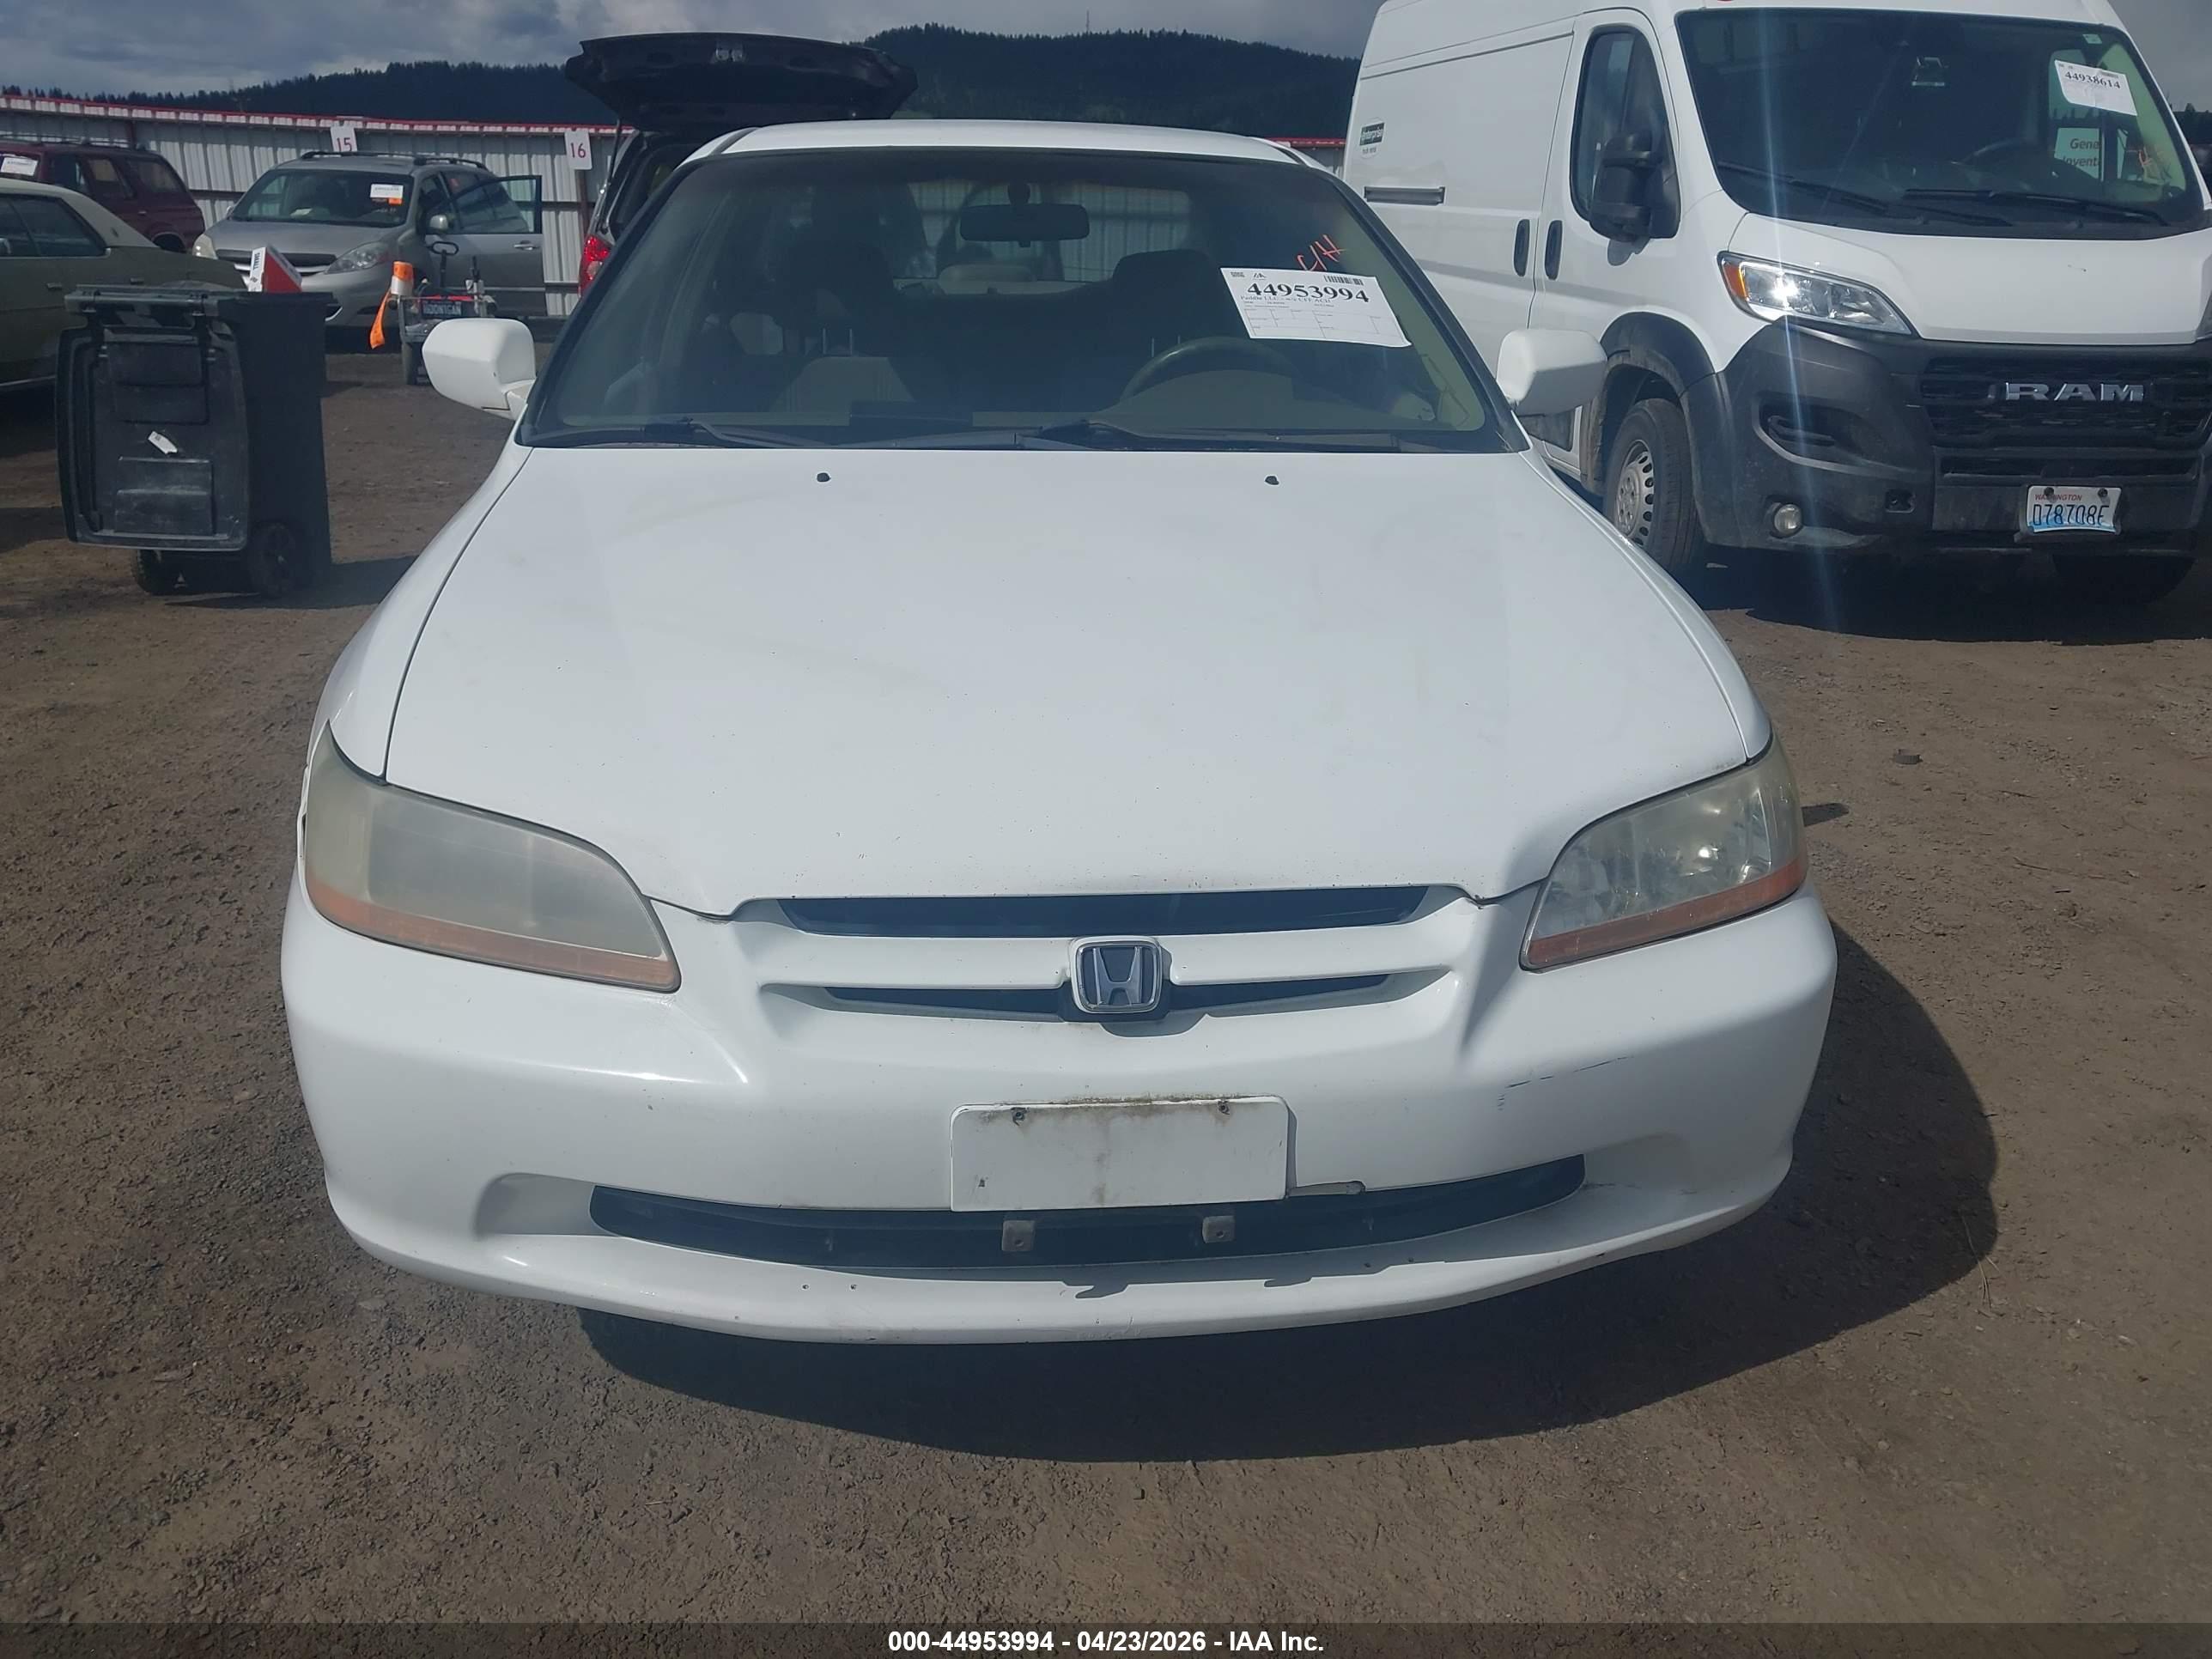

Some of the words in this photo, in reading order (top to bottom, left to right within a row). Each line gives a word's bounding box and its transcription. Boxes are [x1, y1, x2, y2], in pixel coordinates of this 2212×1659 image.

[2065, 71, 2120, 88] 44938614
[337, 137, 352, 152] 15
[571, 143, 586, 158] 16
[1248, 283, 1369, 303] 44953994
[2006, 382, 2144, 402] RAM
